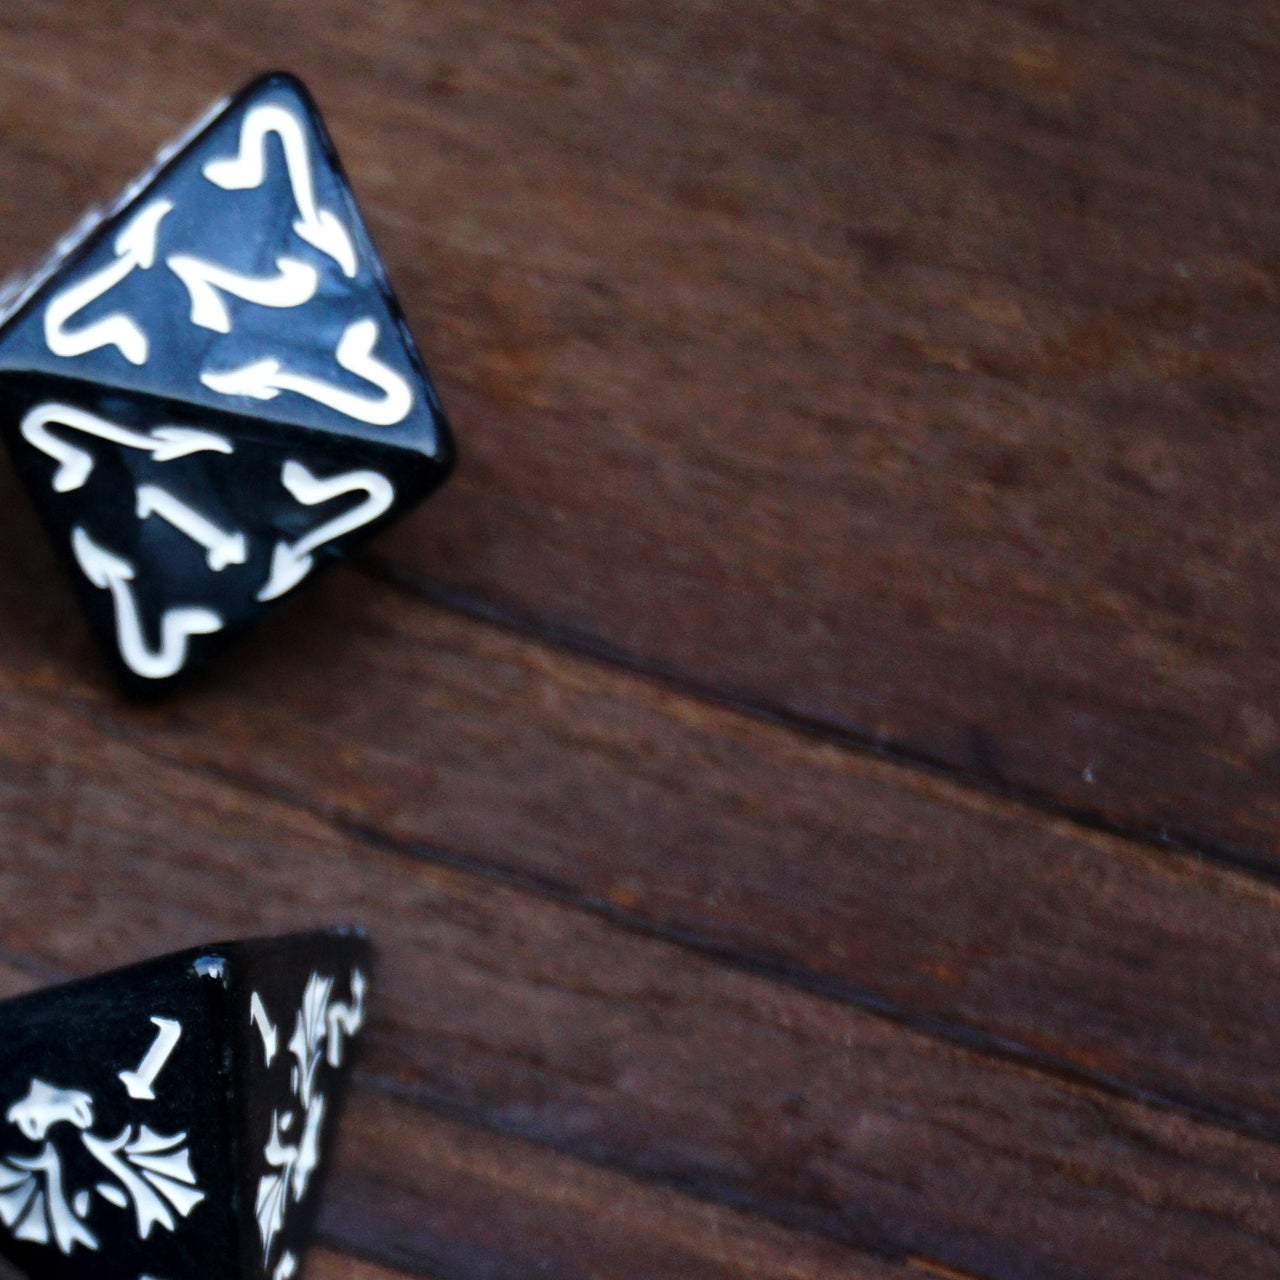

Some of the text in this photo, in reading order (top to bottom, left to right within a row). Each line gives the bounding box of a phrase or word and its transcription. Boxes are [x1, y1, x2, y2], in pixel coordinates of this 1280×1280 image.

[137, 485, 246, 571] 1
[118, 1016, 182, 1100] 1
[250, 991, 277, 1067] 1
